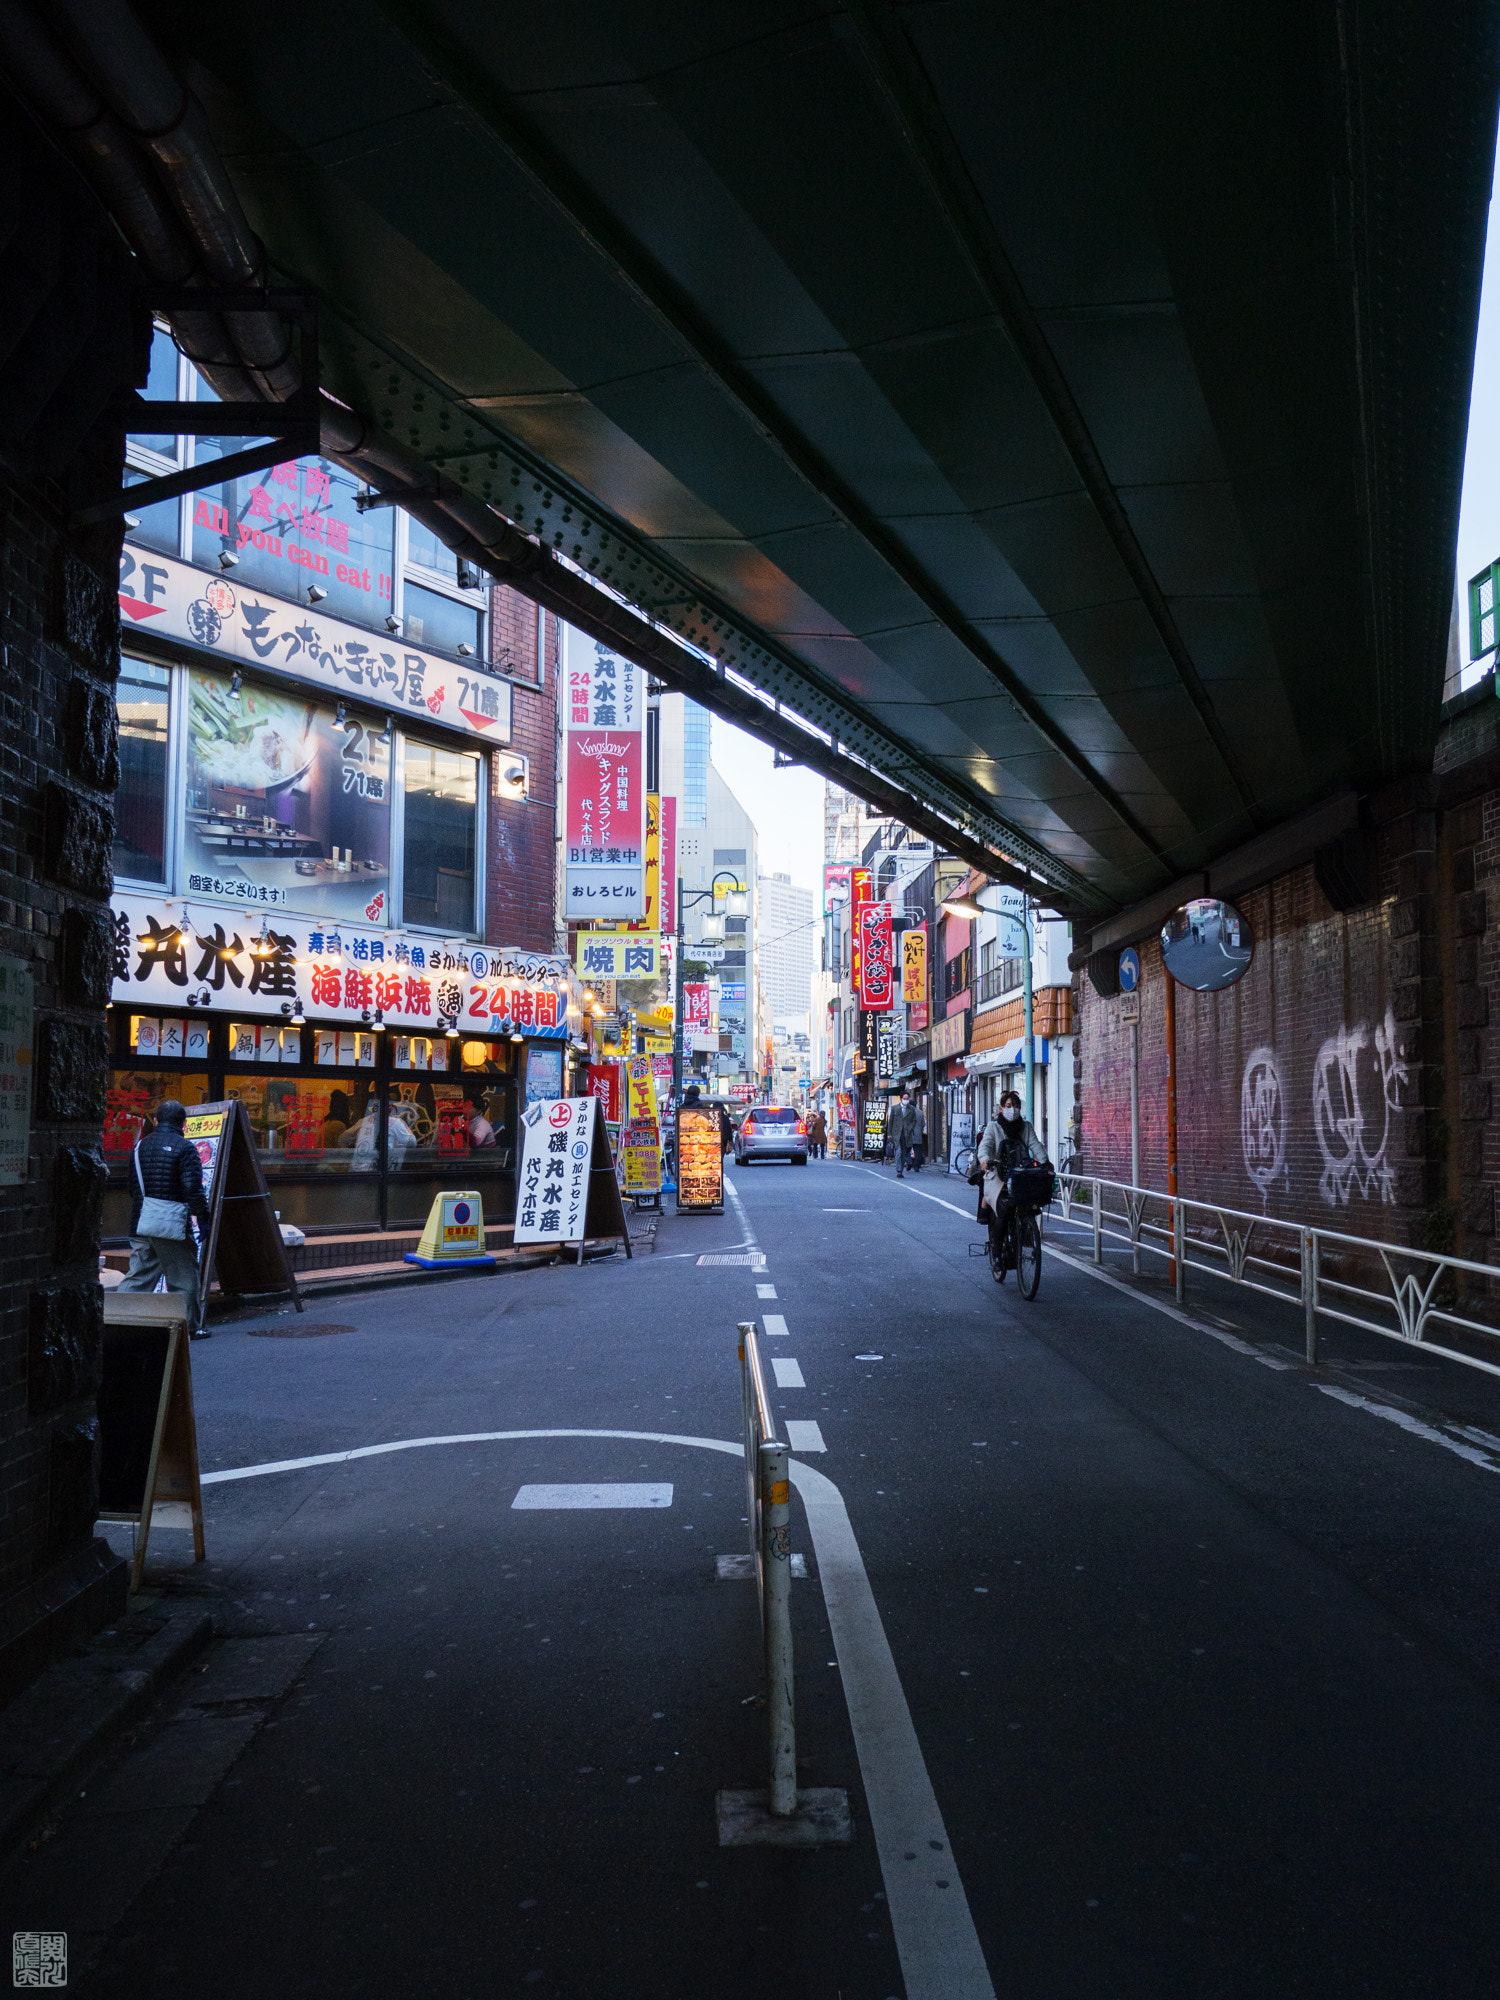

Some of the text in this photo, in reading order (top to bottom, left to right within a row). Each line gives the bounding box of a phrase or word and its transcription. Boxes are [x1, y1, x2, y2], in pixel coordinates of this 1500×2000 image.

[270, 460, 330, 504] 焼肉
[248, 484, 349, 554] 食べ放題
[193, 499, 229, 536] All
[235, 521, 282, 558] you
[287, 543, 330, 576] can
[336, 563, 371, 592] eat
[119, 549, 169, 604] 2F
[457, 676, 499, 718] 71席
[569, 672, 591, 724] 24時間
[343, 767, 384, 799] 71席
[598, 757, 612, 845] キングスランド
[617, 764, 629, 812] 中国料理
[580, 799, 593, 846] 代々木店
[570, 847, 637, 864] B1営業中
[572, 885, 637, 897] おしろビル
[583, 945, 655, 973] 焼肉
[311, 963, 432, 1016] 海鮮浜焼
[469, 984, 558, 1028] 24時間
[692, 993, 700, 1019] スロット
[732, 1085, 755, 1093] カラオケ
[520, 1157, 541, 1228] 代々木店
[539, 1131, 568, 1233] 磯丸水産
